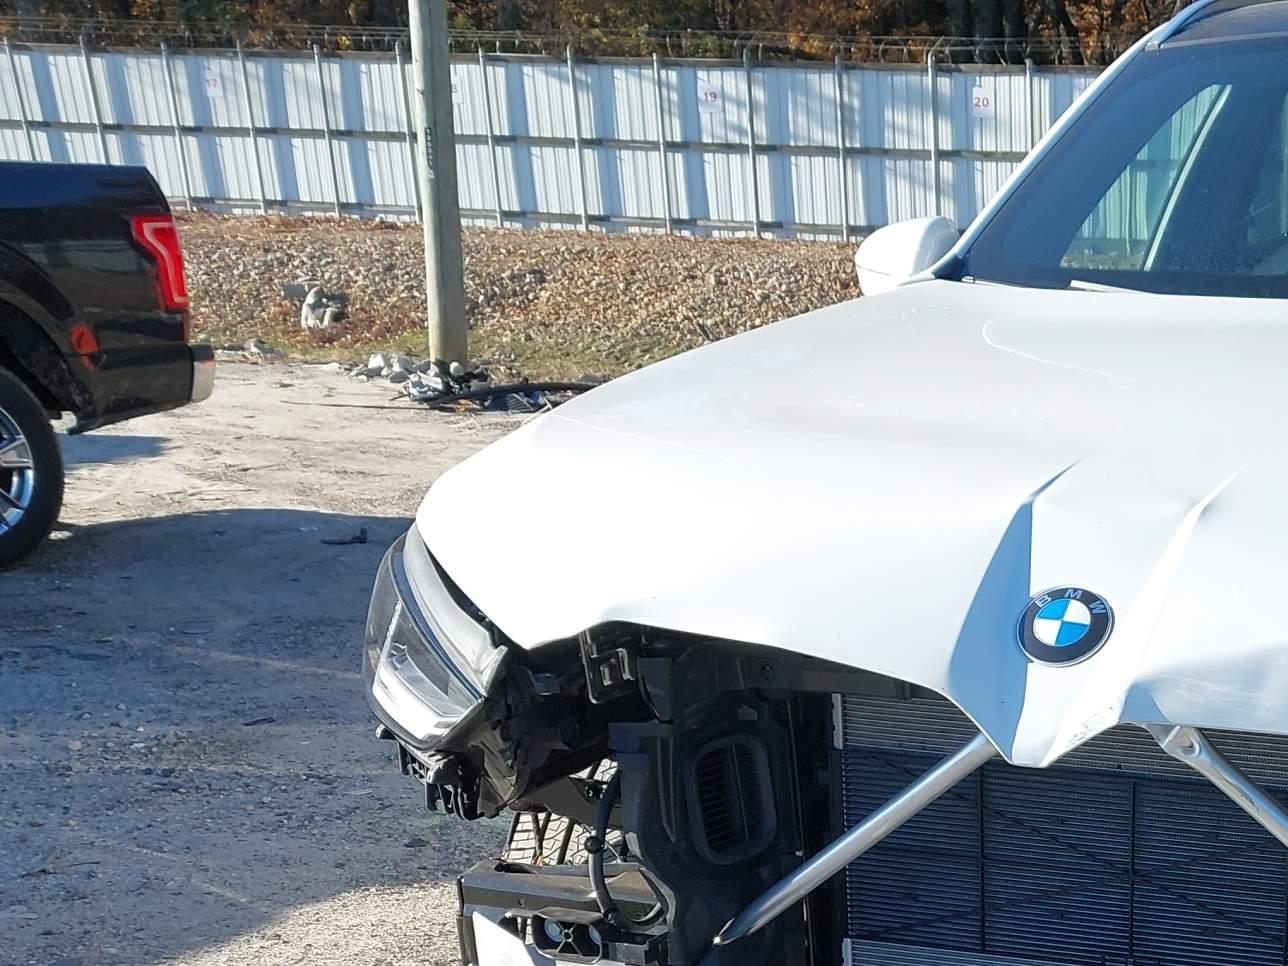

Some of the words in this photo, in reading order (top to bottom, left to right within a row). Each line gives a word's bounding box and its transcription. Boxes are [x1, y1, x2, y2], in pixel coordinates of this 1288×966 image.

[704, 91, 717, 103] 19
[975, 96, 990, 108] 20
[1034, 588, 1107, 614] BMW
